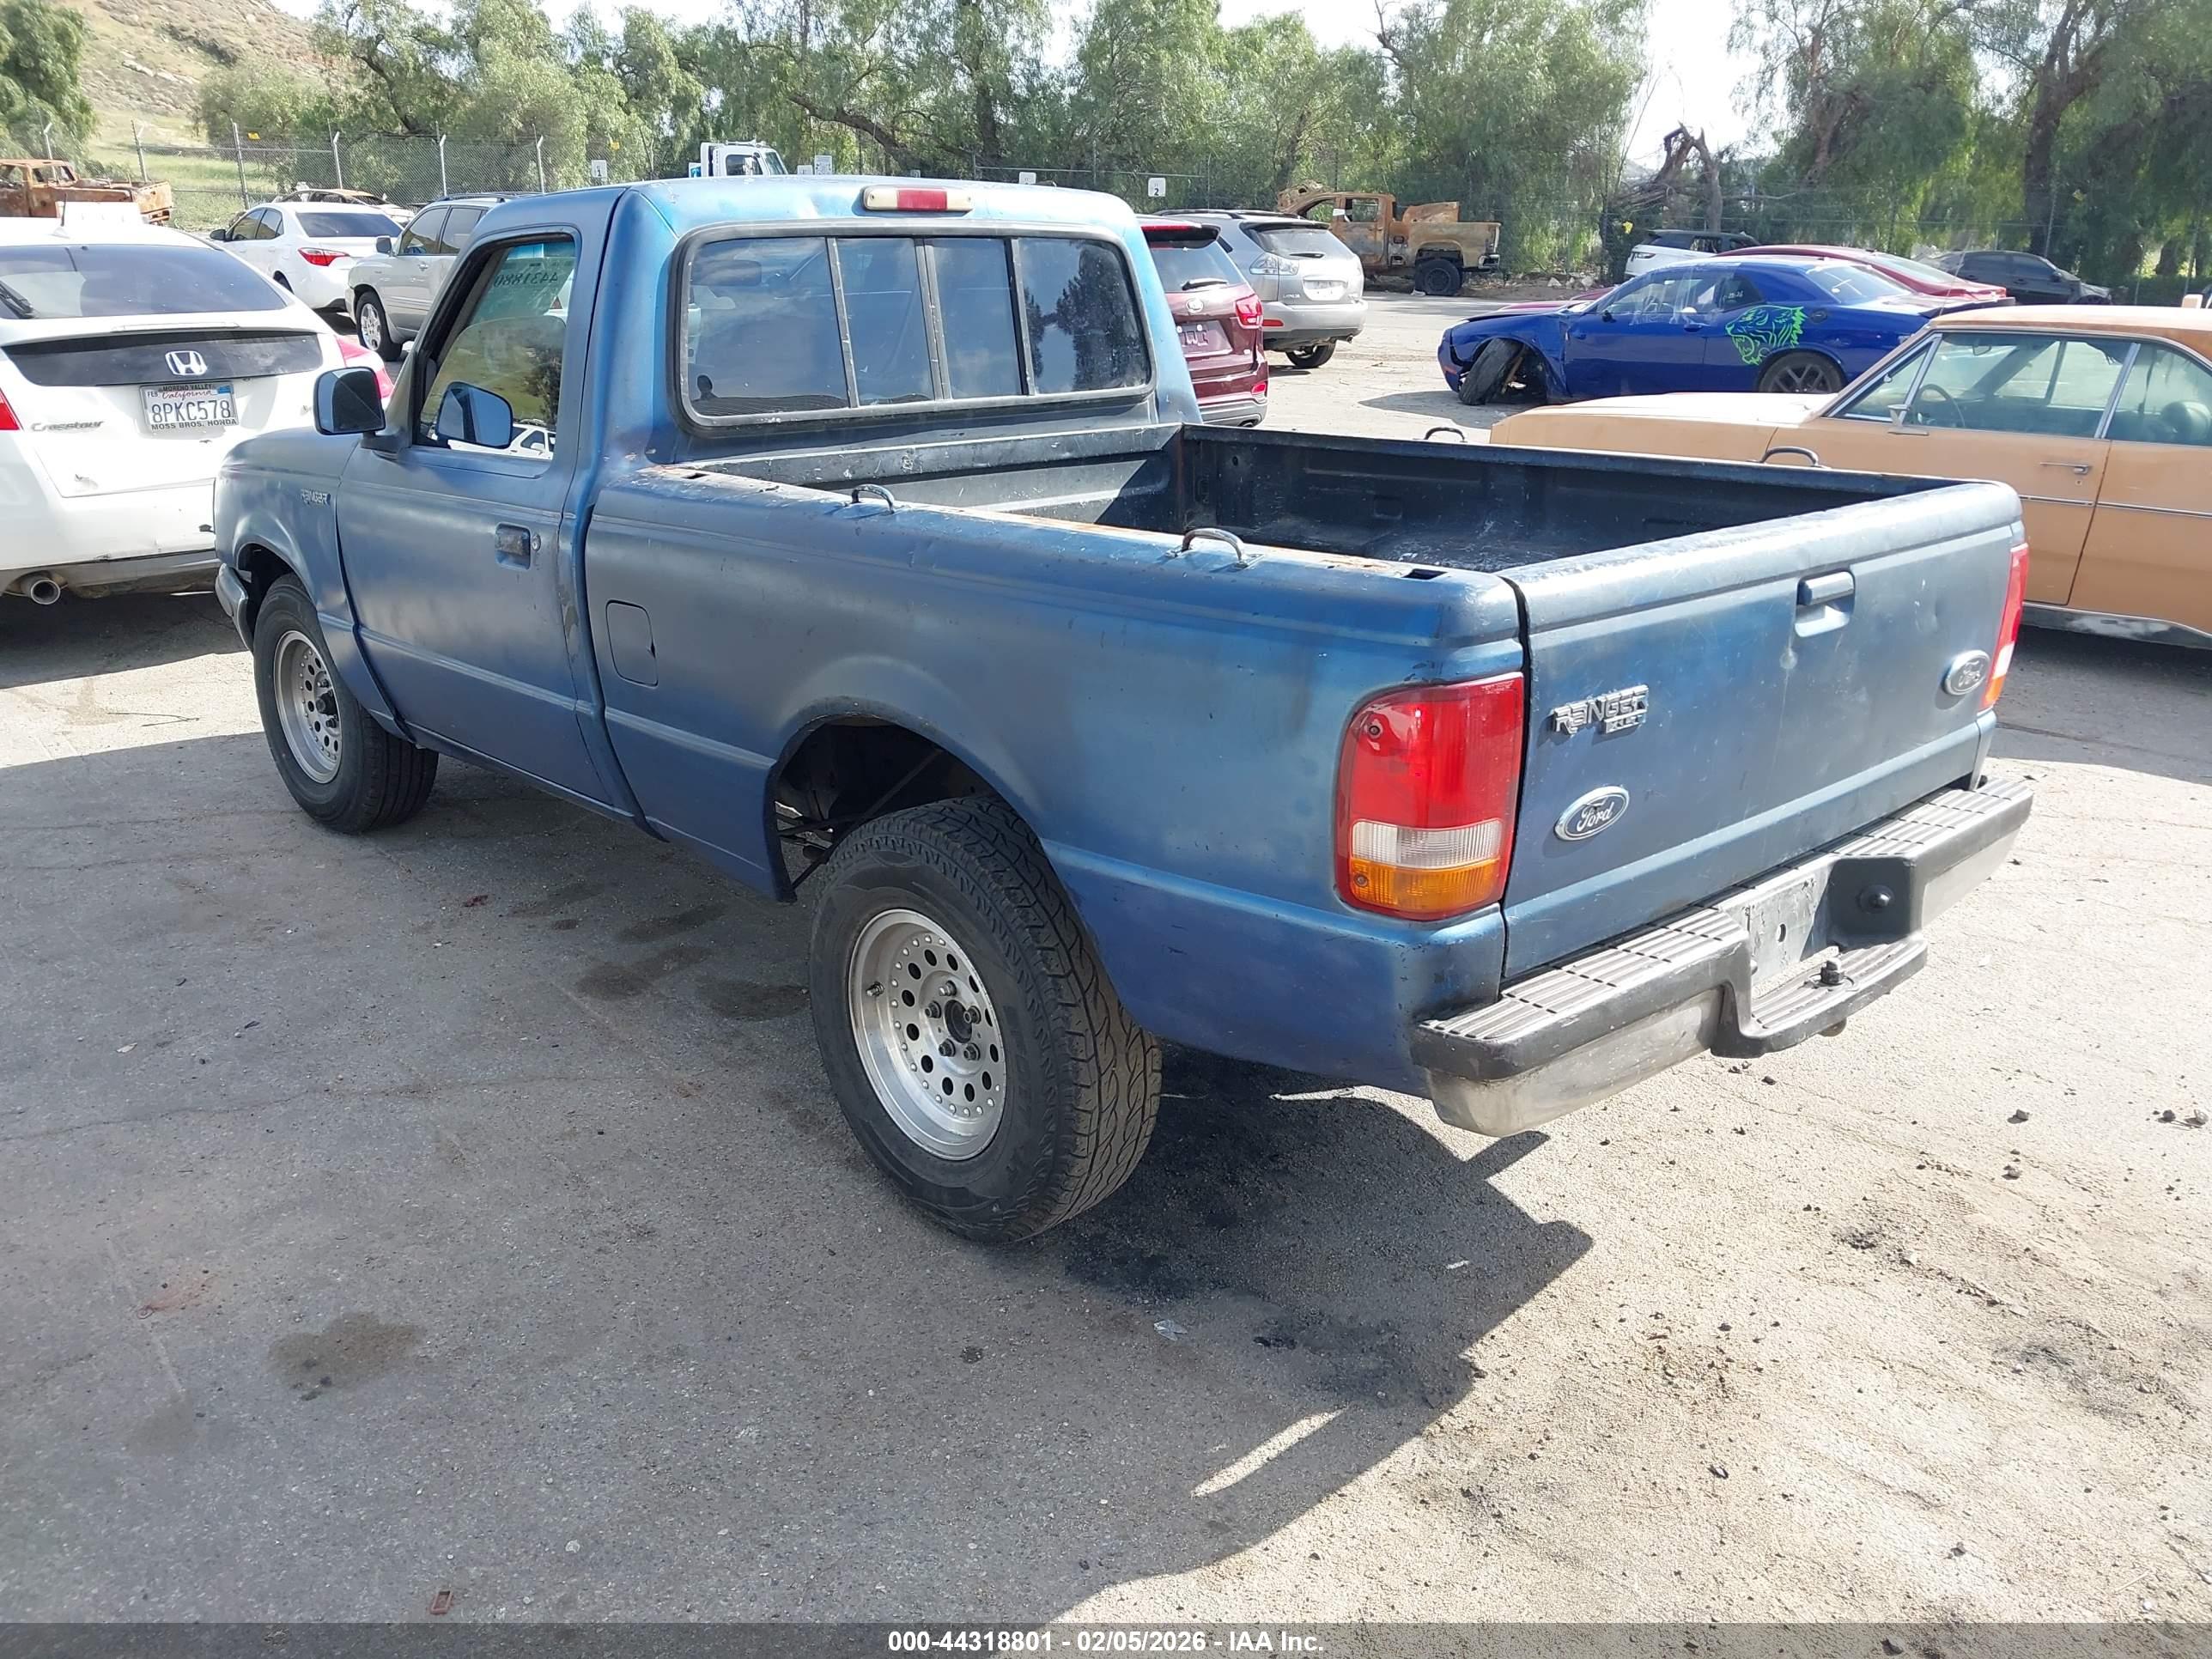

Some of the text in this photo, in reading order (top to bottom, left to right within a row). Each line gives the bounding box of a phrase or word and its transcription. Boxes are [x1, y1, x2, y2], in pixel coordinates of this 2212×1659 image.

[1153, 187, 1159, 196] 2
[161, 389, 214, 401] California
[151, 399, 231, 423] 8PKC578
[207, 418, 237, 427] HONDA
[1554, 684, 1649, 734] RANGER
